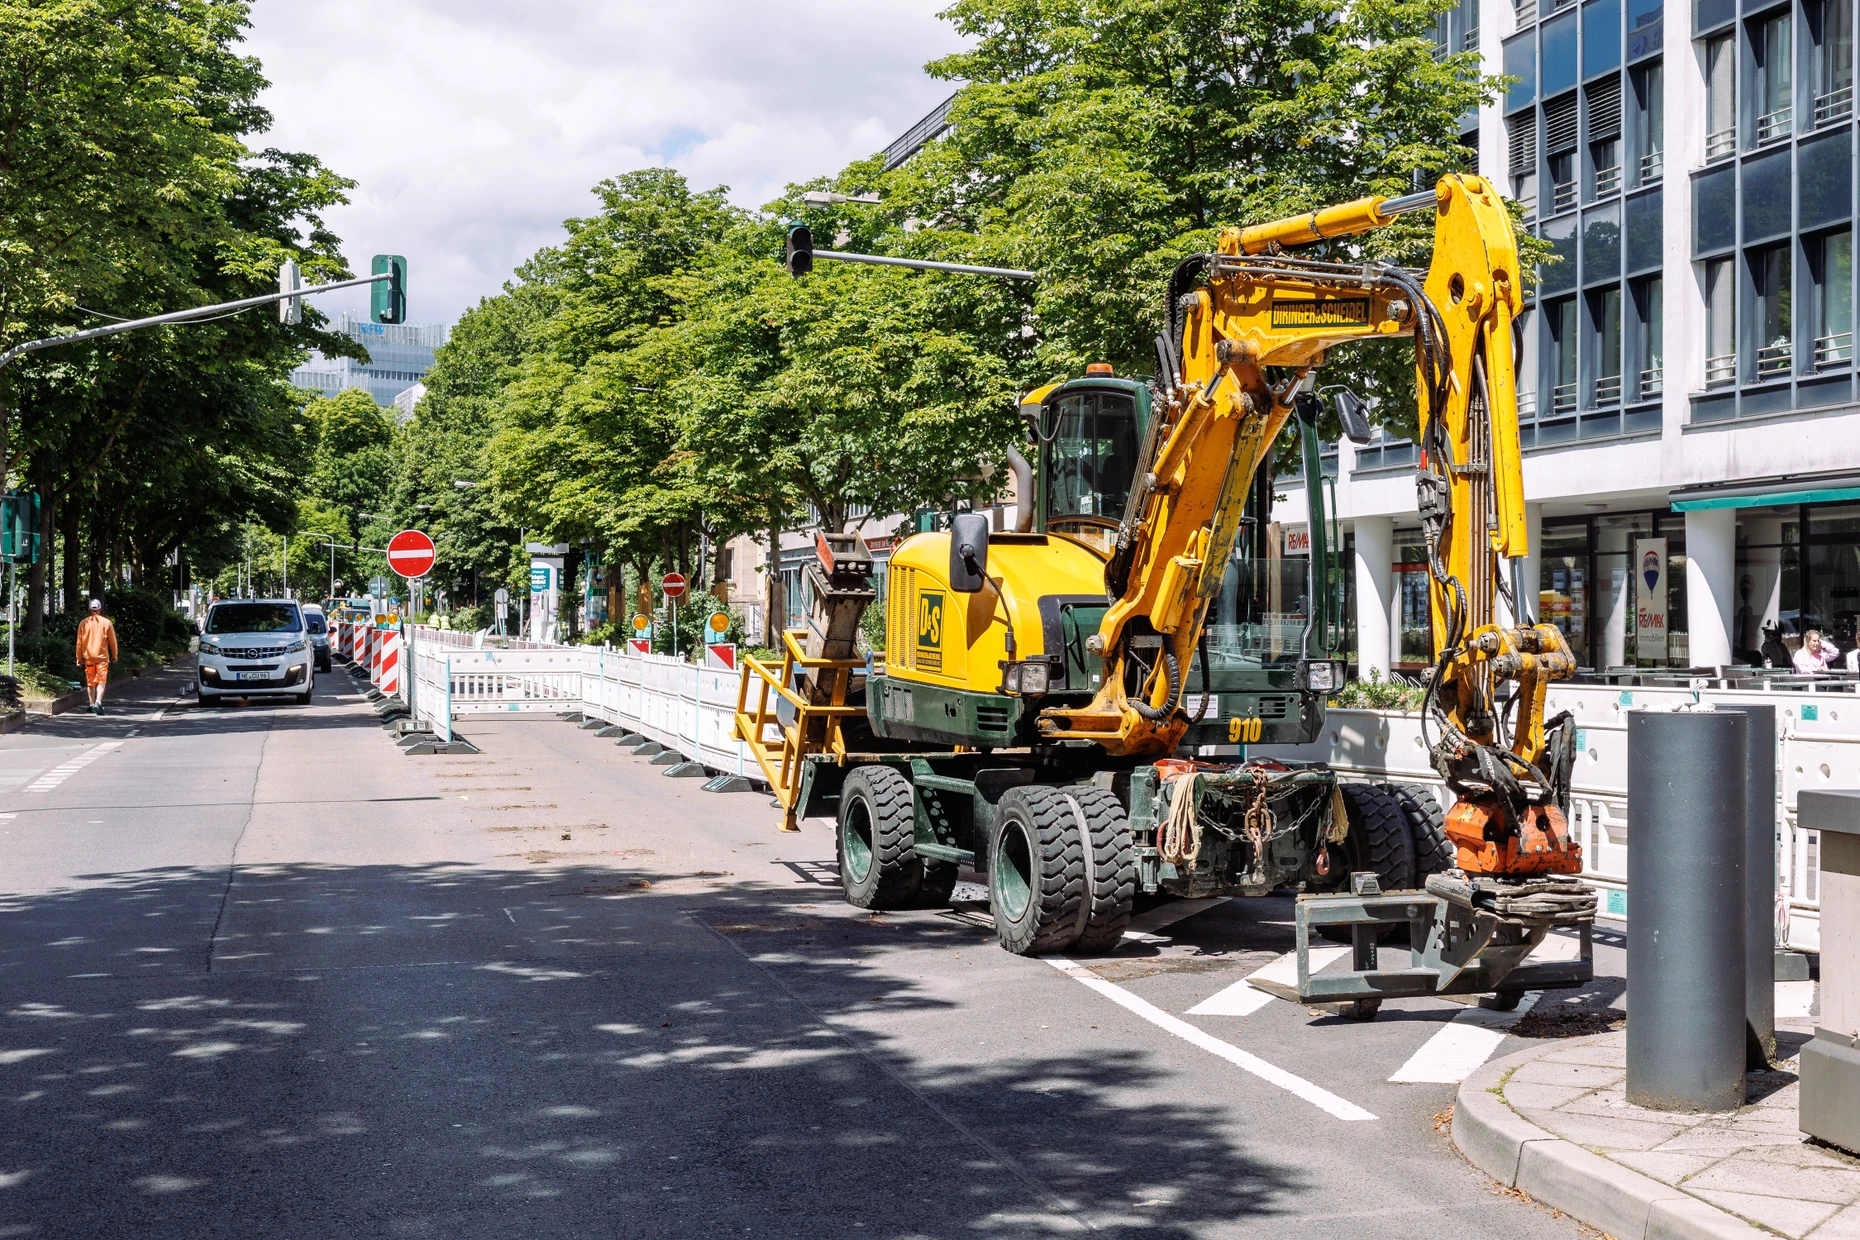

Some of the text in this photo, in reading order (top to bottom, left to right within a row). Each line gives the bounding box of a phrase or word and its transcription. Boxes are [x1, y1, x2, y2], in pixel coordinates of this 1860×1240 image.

[920, 597, 940, 643] D&S
[1639, 613, 1664, 628] RE/MAX
[1228, 717, 1262, 743] 910
